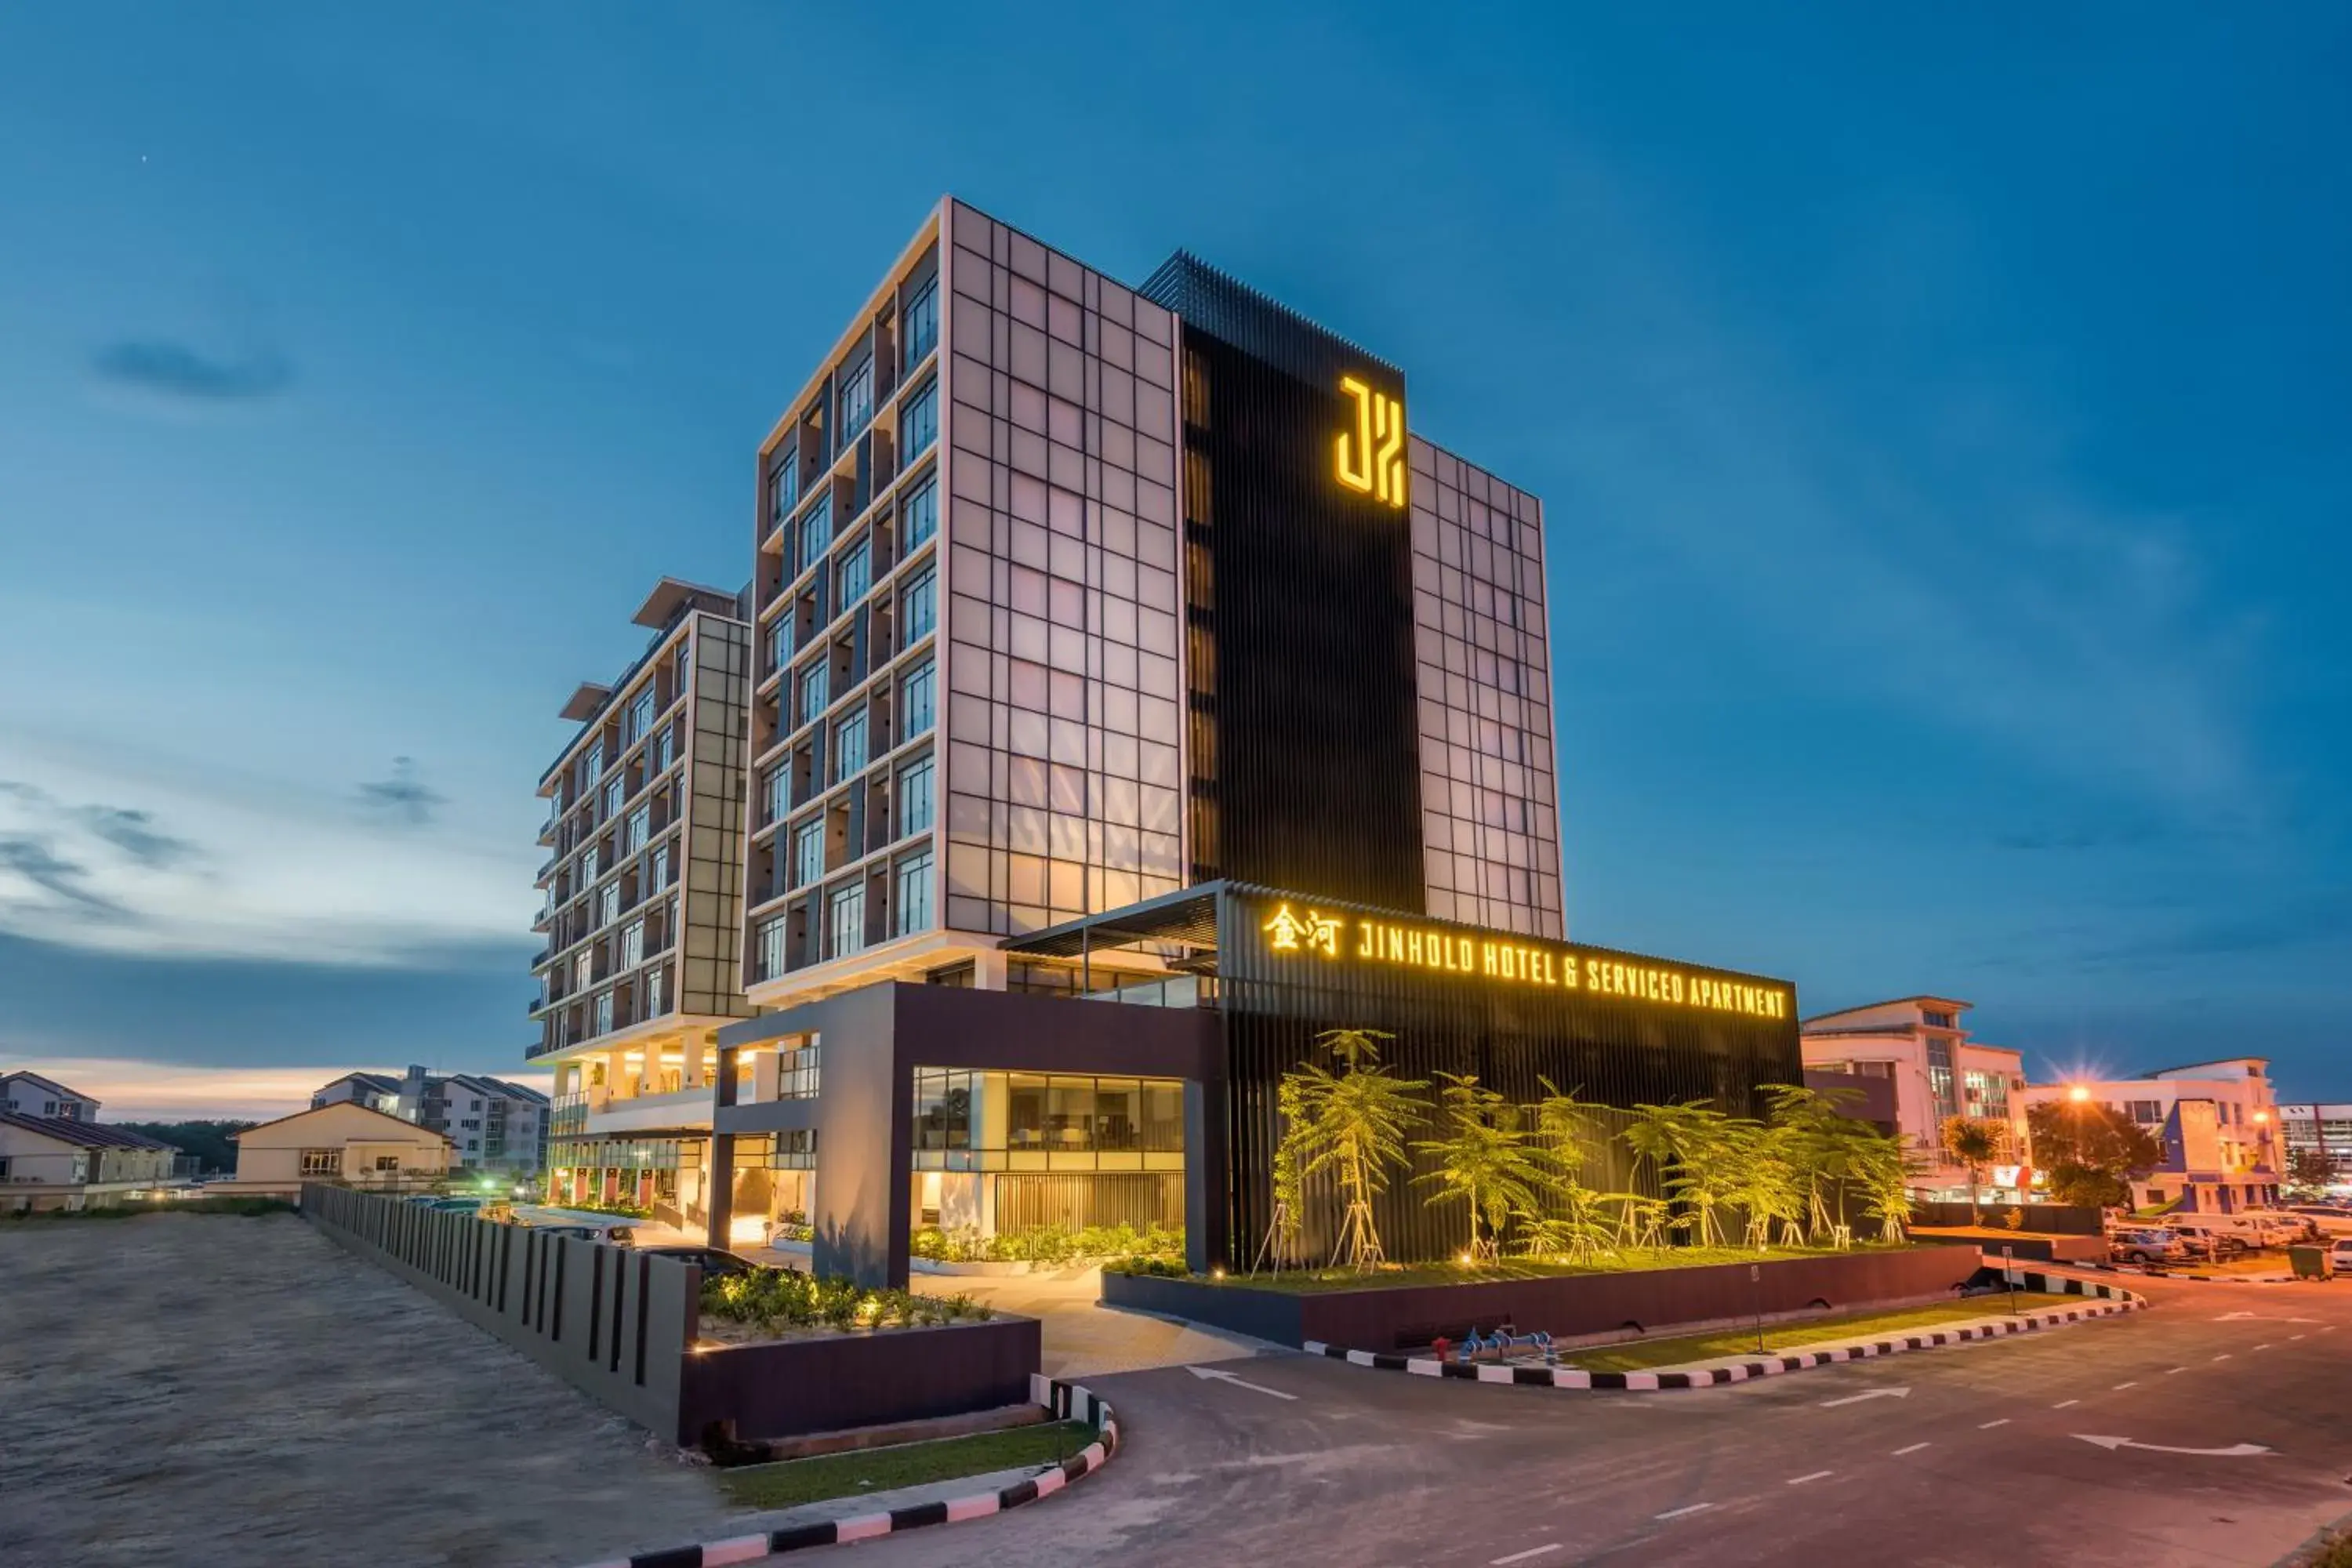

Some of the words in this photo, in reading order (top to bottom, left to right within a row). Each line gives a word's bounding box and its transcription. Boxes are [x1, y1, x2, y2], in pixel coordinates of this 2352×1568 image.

[1262, 903, 1343, 955] 金河
[1359, 921, 1474, 972] JINHOLD
[1483, 942, 1556, 985] HOTEL
[1564, 956, 1577, 988] &
[1587, 960, 1683, 1004] SERVICED
[1690, 977, 1785, 1018] APARTMENT
